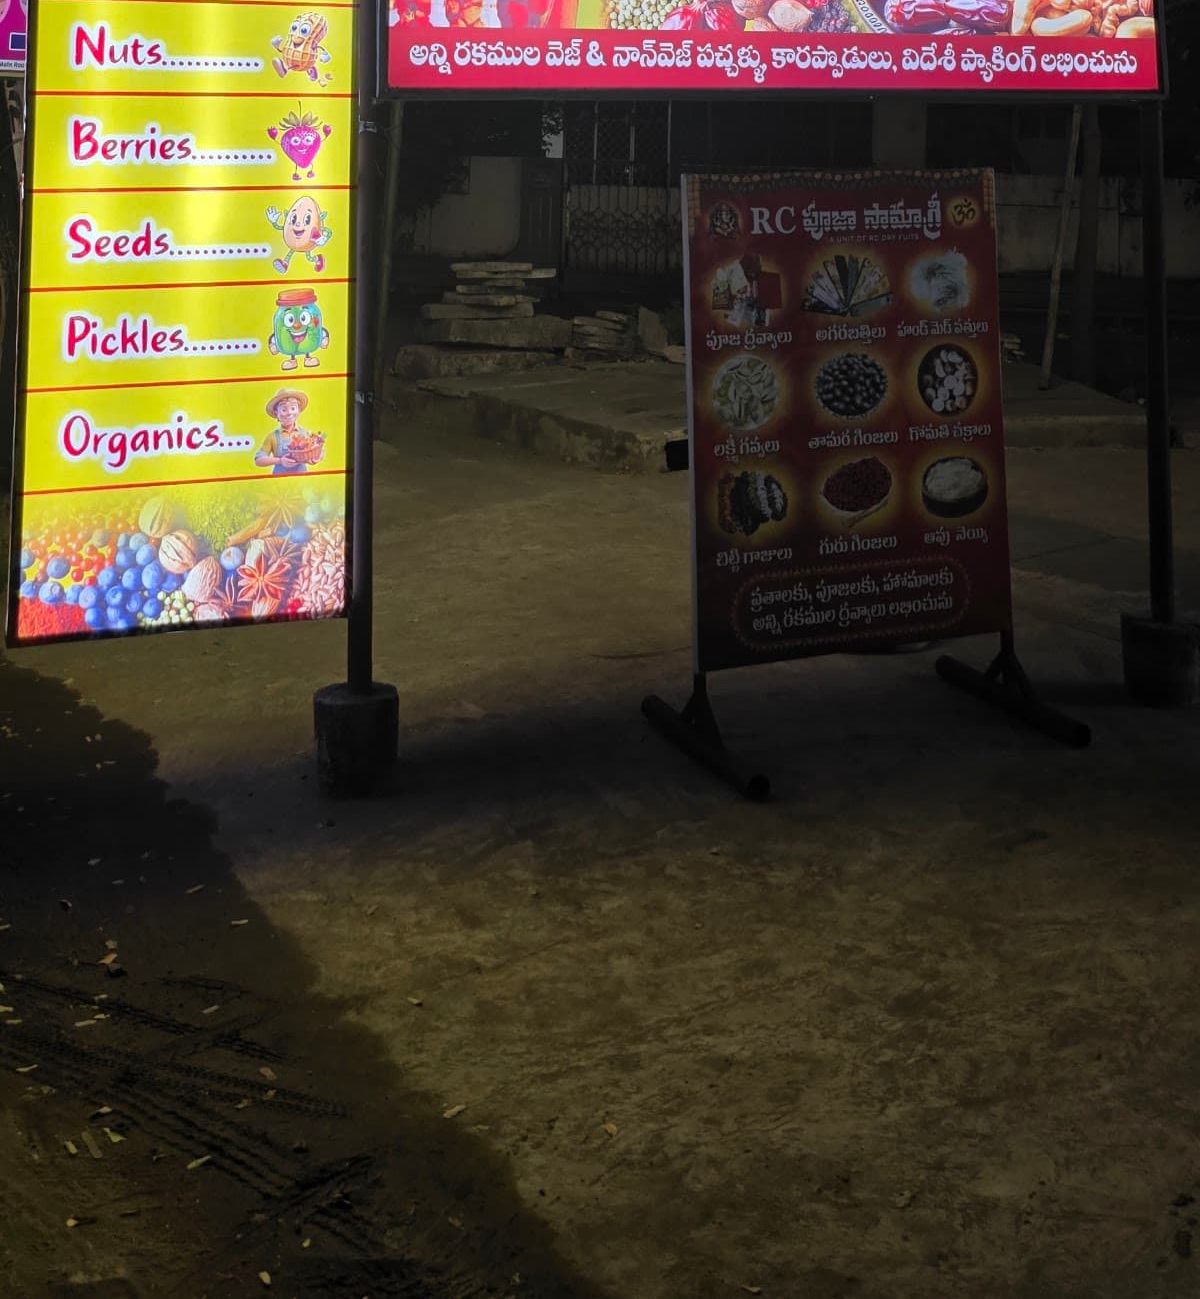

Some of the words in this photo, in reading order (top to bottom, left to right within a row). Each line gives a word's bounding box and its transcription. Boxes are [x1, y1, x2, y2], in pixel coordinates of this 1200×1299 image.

[409, 43, 452, 75] అన్ని
[453, 41, 541, 66] రకముల
[545, 39, 582, 67] వెజ్
[587, 41, 607, 66] &
[901, 42, 956, 71] విదేశీ
[960, 45, 1037, 83] ప్యాకింగ్
[1041, 49, 1138, 77] లభించును
[750, 206, 797, 235] RC
